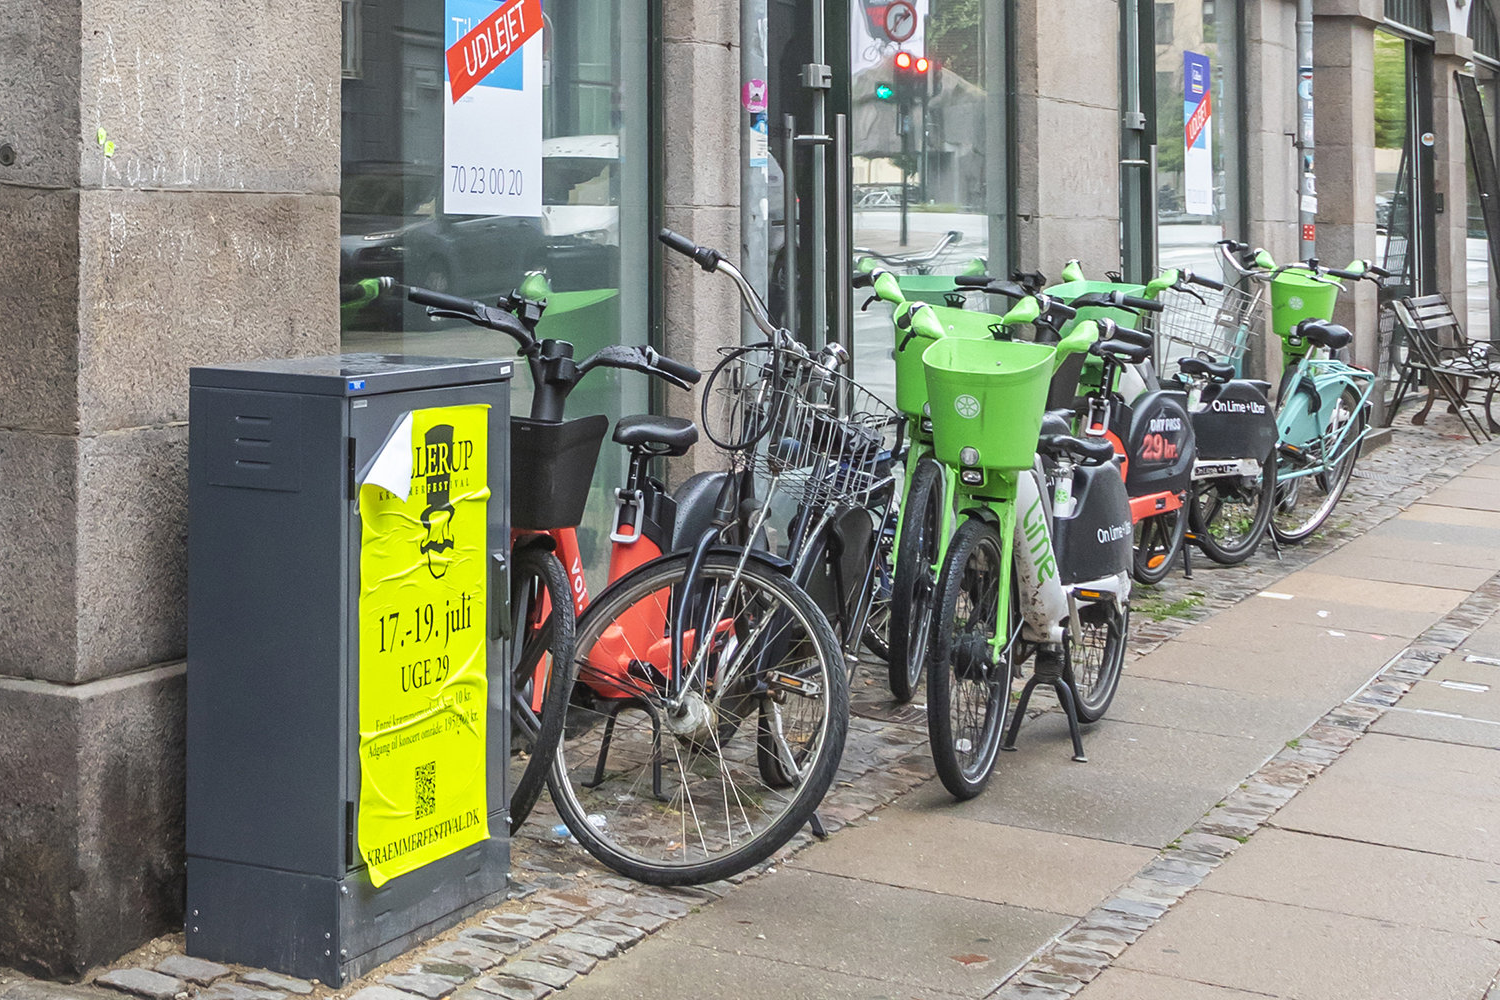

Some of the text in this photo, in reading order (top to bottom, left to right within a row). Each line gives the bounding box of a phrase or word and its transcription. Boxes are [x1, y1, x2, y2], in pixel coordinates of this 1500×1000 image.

[451, 165, 523, 196] 70 23 00 20
[1212, 399, 1227, 413] On
[1227, 400, 1246, 414] Lime
[1142, 433, 1163, 461] 29
[1023, 496, 1056, 583] Lime
[1097, 528, 1111, 544] On
[379, 591, 472, 653] 17.-19. juli
[401, 655, 450, 693] UGE 29
[367, 808, 481, 868] KRAEMMERFESTIVAL.DK
